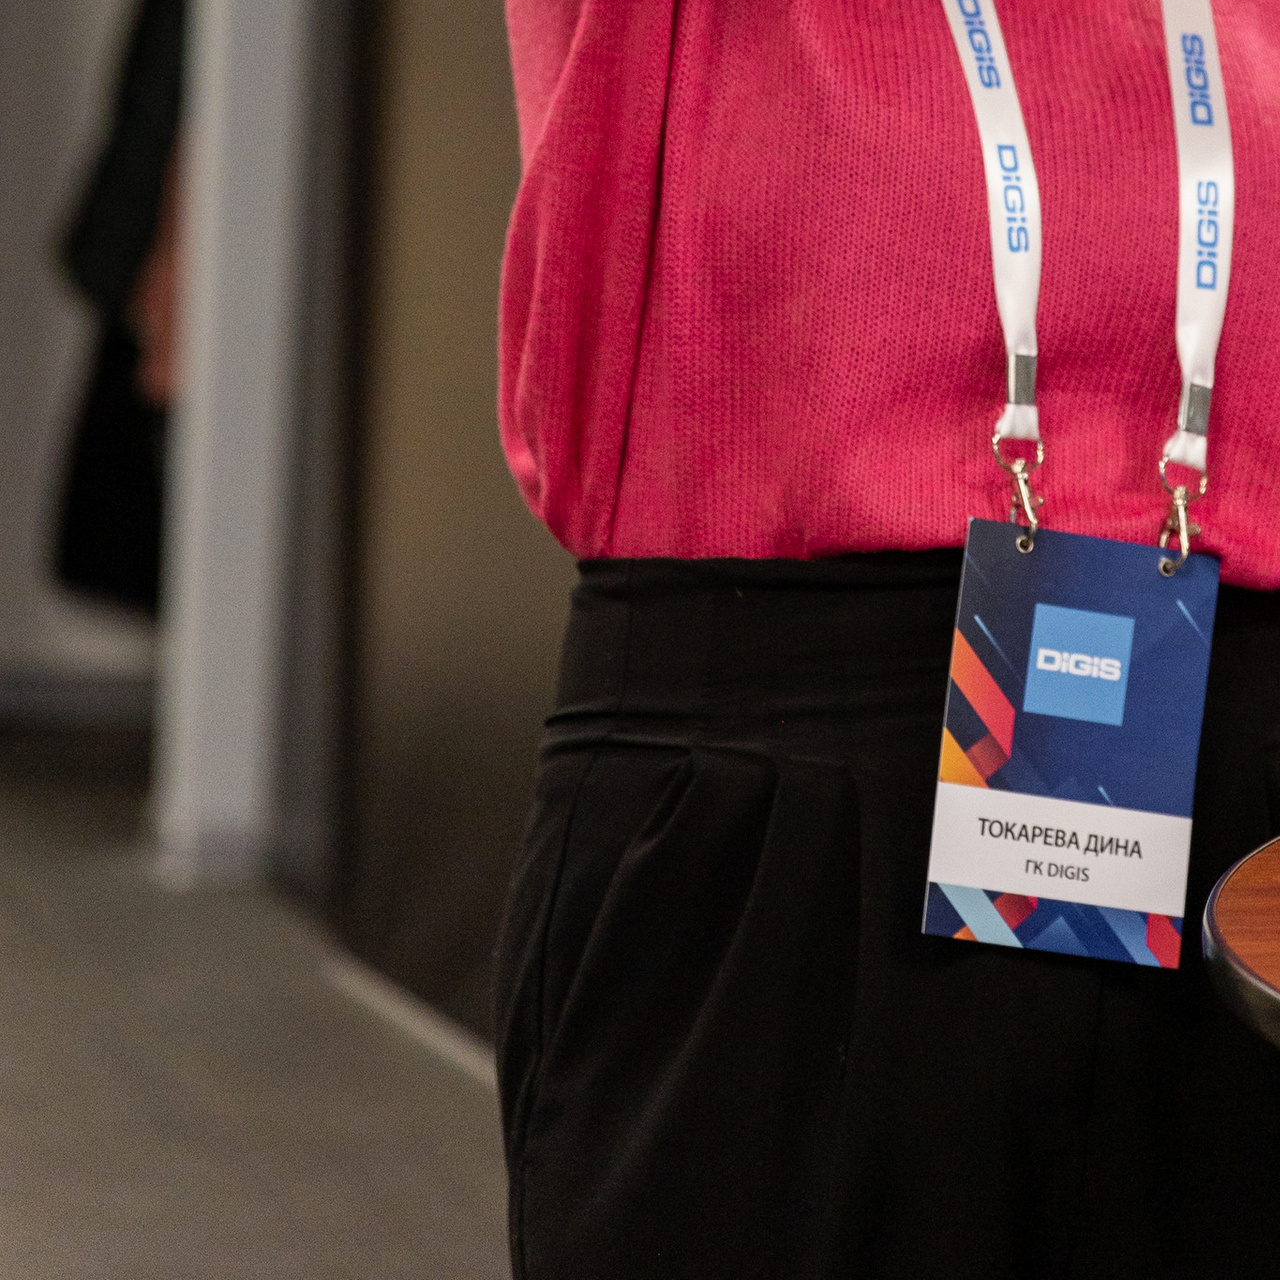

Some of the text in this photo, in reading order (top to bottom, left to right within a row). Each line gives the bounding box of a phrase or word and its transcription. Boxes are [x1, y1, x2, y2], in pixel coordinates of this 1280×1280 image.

[978, 817, 1143, 860] ТОКАРЕВА ДИНА
[1025, 859, 1091, 883] ГК DIGIS
